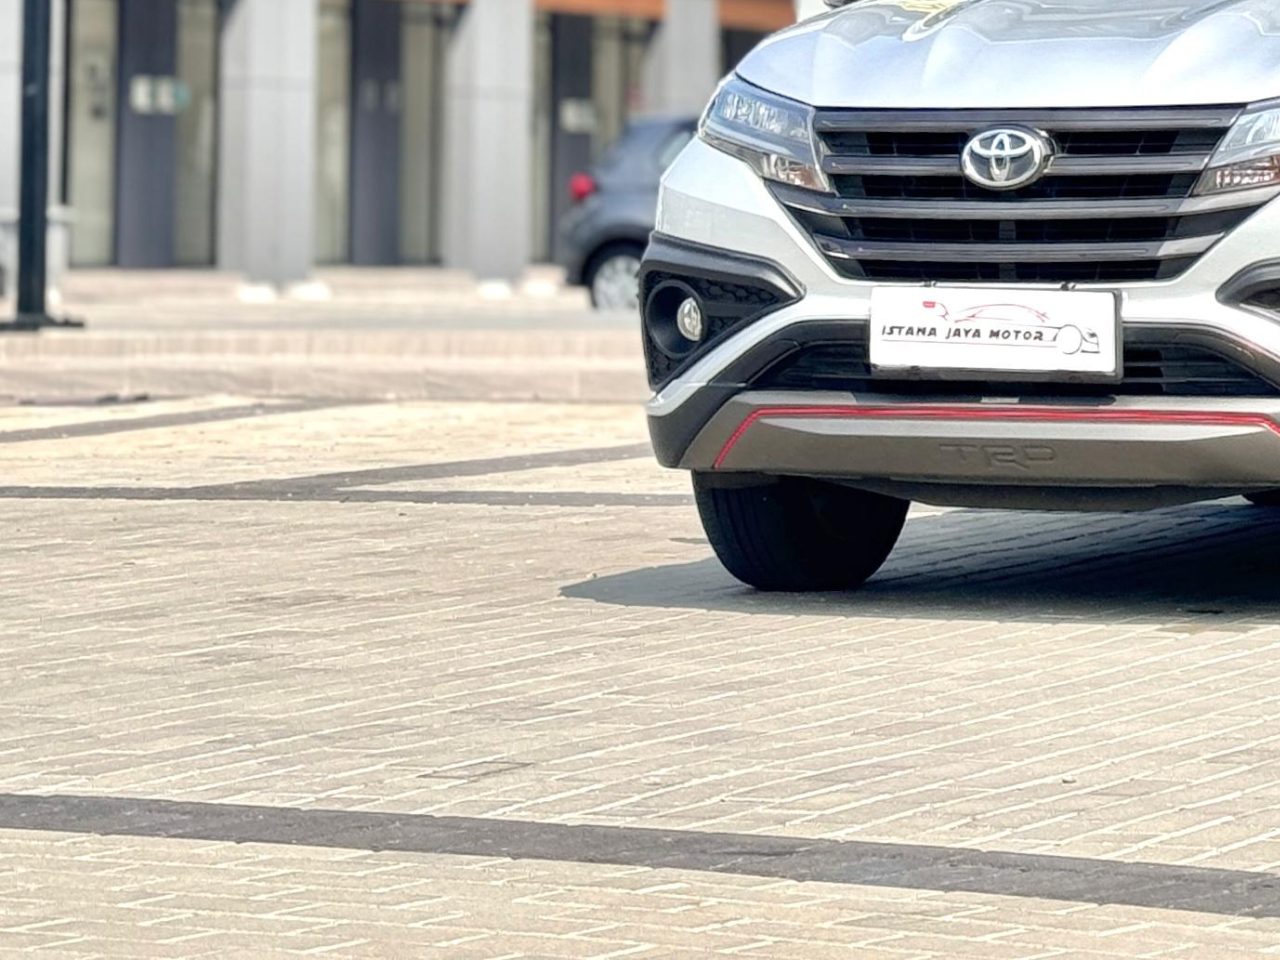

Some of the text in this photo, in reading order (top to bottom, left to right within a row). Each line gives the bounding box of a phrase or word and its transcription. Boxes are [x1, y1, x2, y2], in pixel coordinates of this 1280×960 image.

[881, 324, 1044, 342] ISTANA JAYA MOTOR
[938, 443, 1056, 470] TRD
